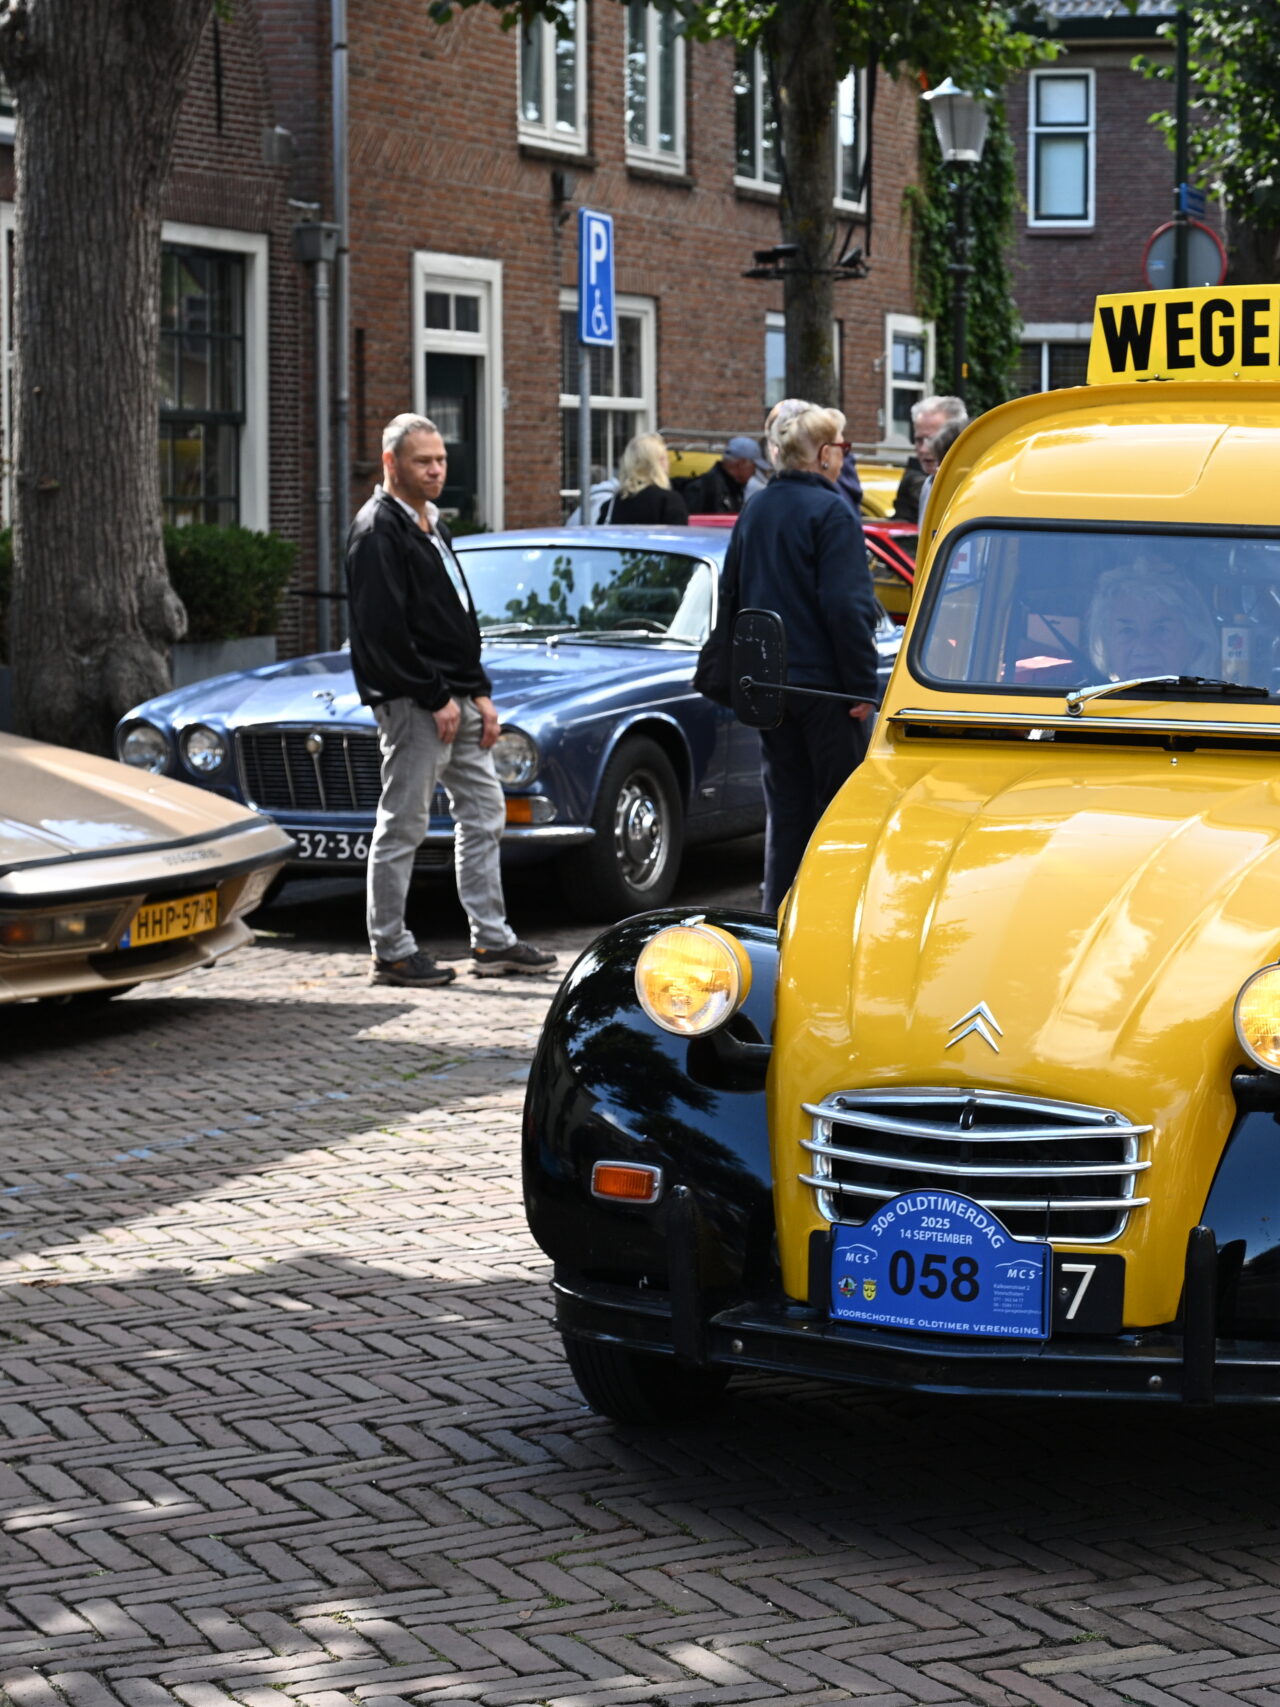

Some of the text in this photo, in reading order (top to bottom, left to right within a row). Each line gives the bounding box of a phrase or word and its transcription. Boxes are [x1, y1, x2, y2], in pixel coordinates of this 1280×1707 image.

[589, 219, 608, 285] P
[137, 895, 213, 940] HHP-57-R
[871, 1196, 1005, 1249] 30e OLDTIMERDAG
[900, 1229, 973, 1245] 14 SEPTEMBER
[920, 1216, 950, 1229] 2025
[888, 1249, 980, 1302] 058
[1061, 1263, 1096, 1319] 7
[837, 1308, 1039, 1335] VOORSCHOTENSE OLDTIMER VERENIGING
